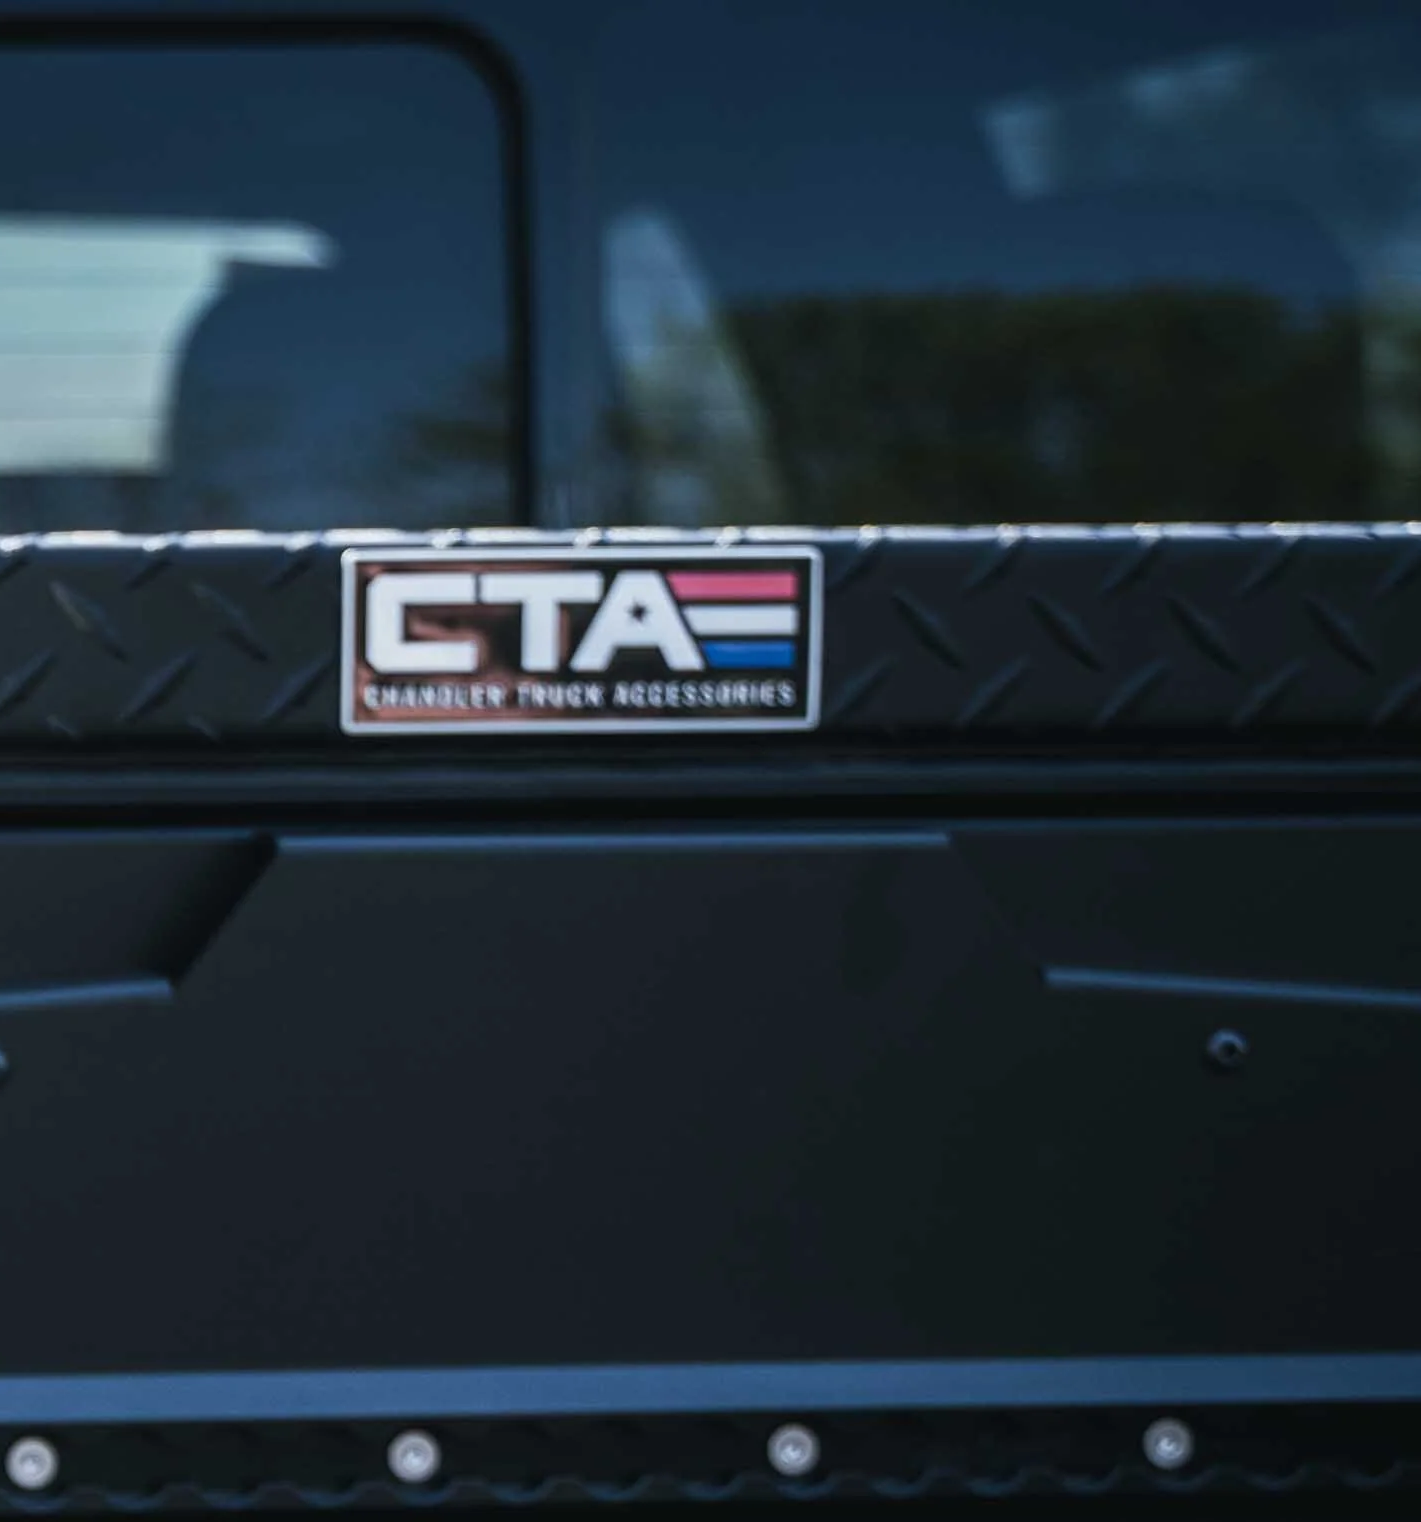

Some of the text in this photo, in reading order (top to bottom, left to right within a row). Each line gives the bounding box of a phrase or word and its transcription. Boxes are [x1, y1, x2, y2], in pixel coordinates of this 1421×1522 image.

[366, 569, 705, 673] CTA
[364, 680, 796, 710] CHANDLER TRUCK ACCESSORIES
